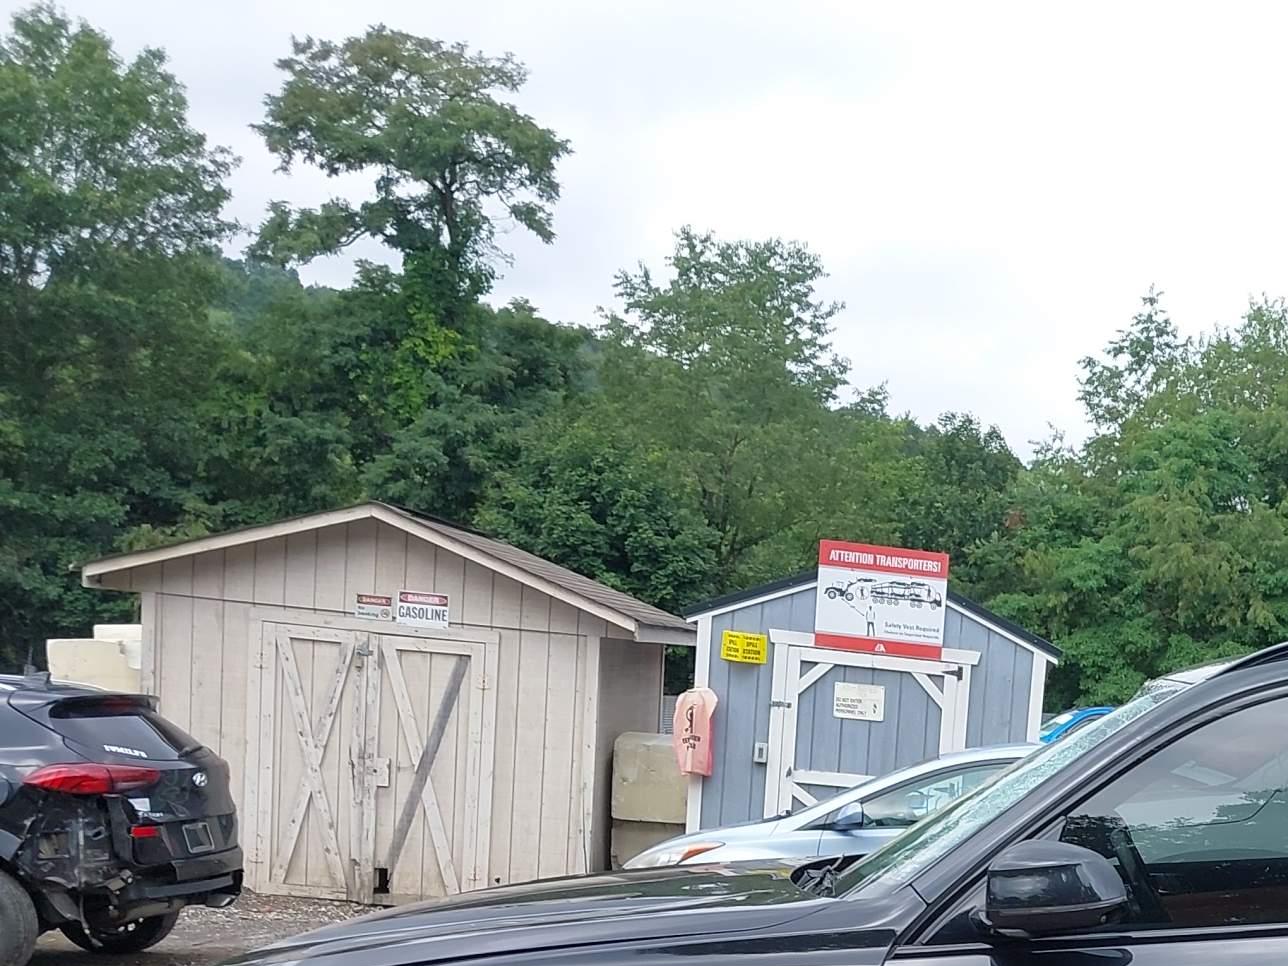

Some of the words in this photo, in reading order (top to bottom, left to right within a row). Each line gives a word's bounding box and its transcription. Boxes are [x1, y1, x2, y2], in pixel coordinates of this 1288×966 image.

[829, 549, 874, 565] ATTENTION
[876, 554, 941, 573] TRANSPORTERS!
[398, 605, 448, 622] GASOLINE
